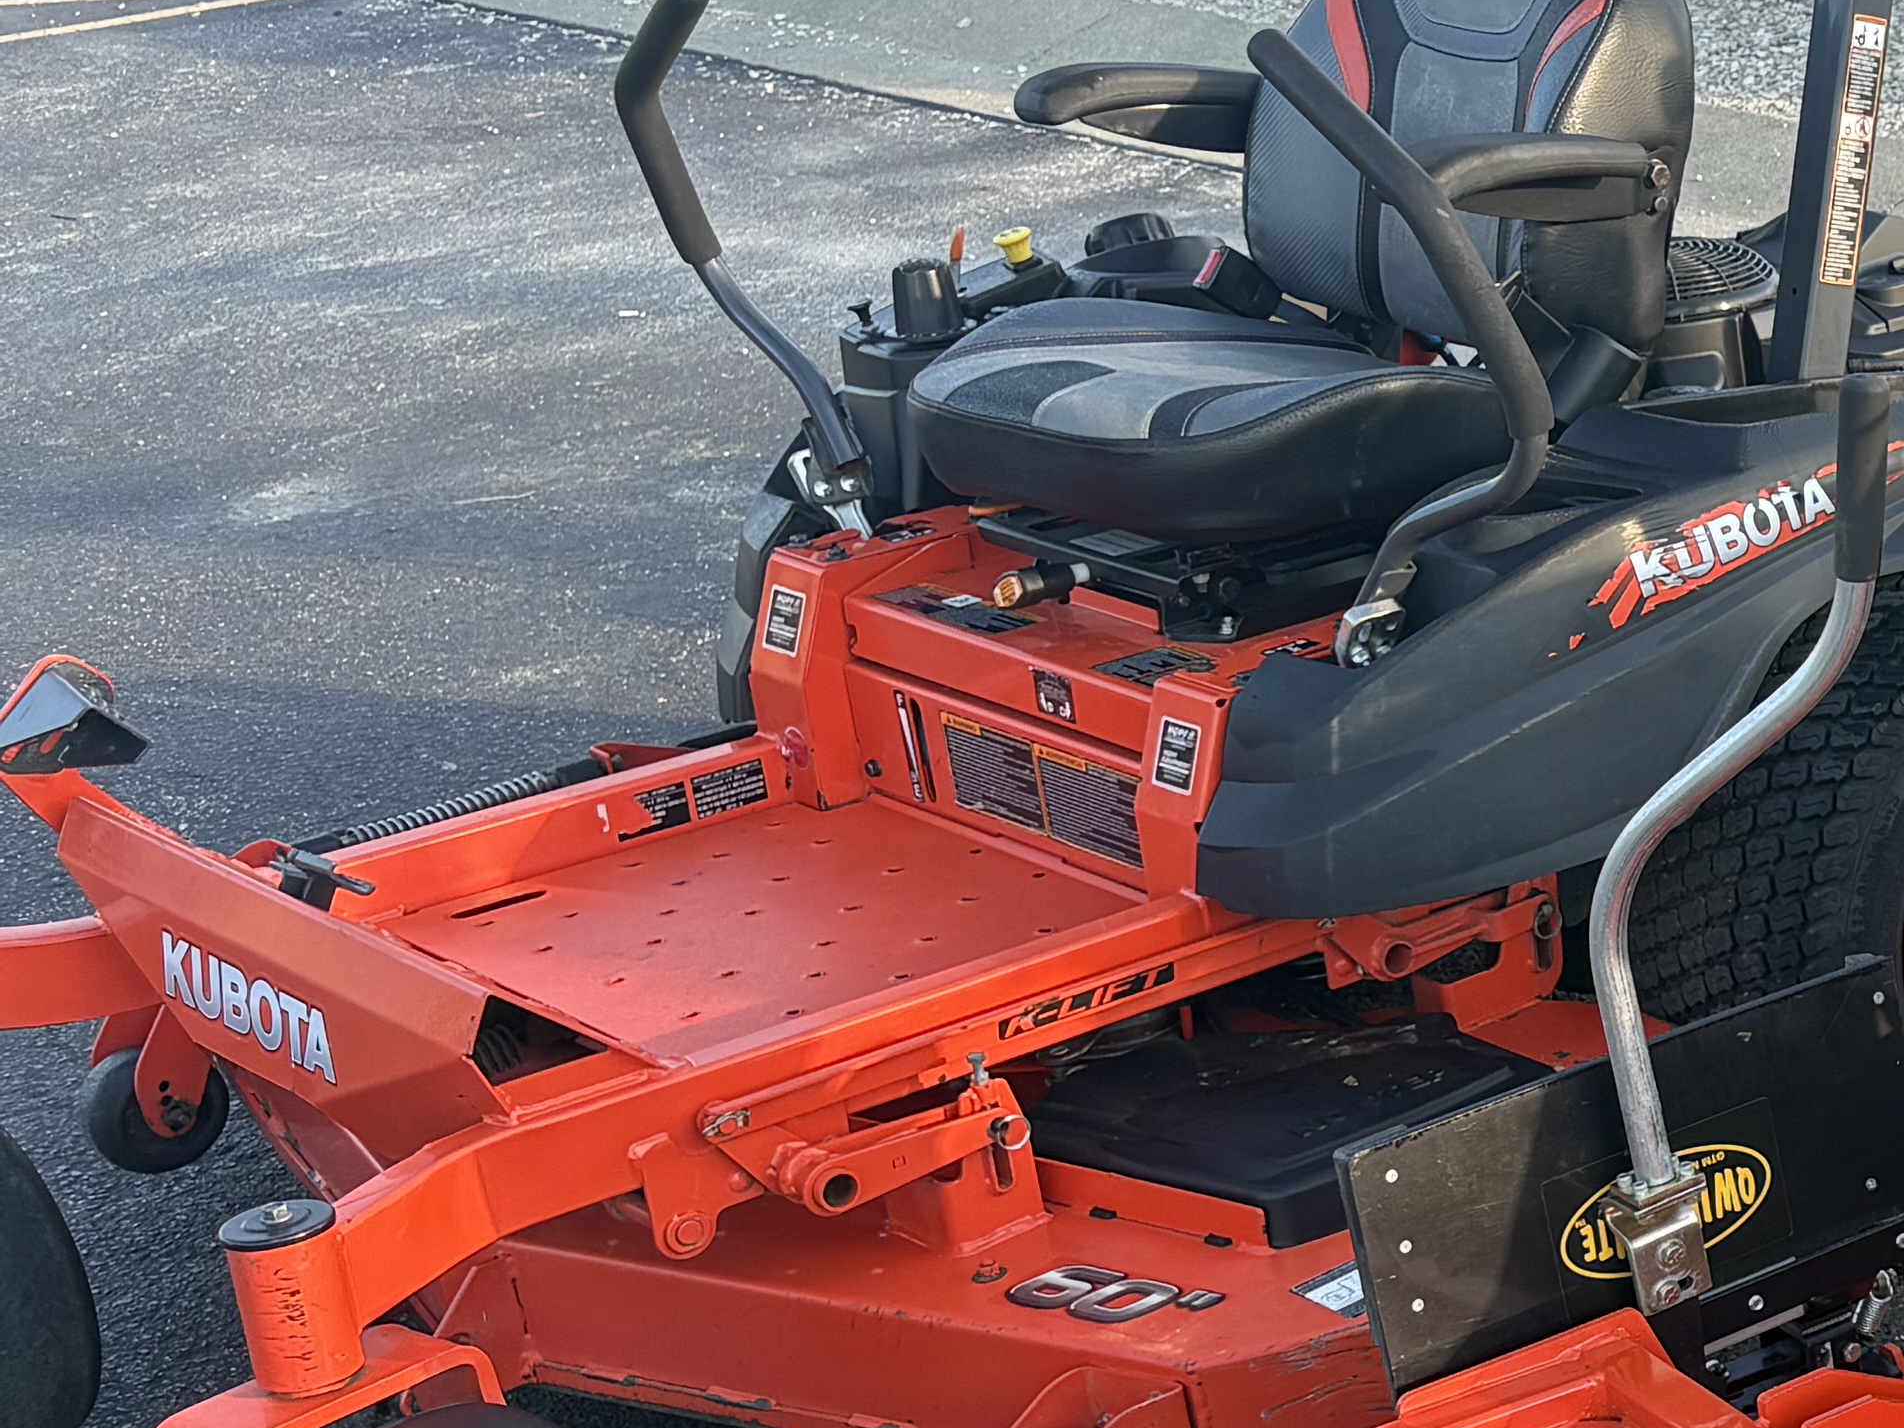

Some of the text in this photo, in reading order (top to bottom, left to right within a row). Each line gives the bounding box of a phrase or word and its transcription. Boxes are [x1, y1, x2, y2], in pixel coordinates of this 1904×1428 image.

[1631, 477, 1836, 599] KUBOTA
[160, 928, 339, 1086] KUBOTA
[1003, 964, 1171, 1039] K-LIFT
